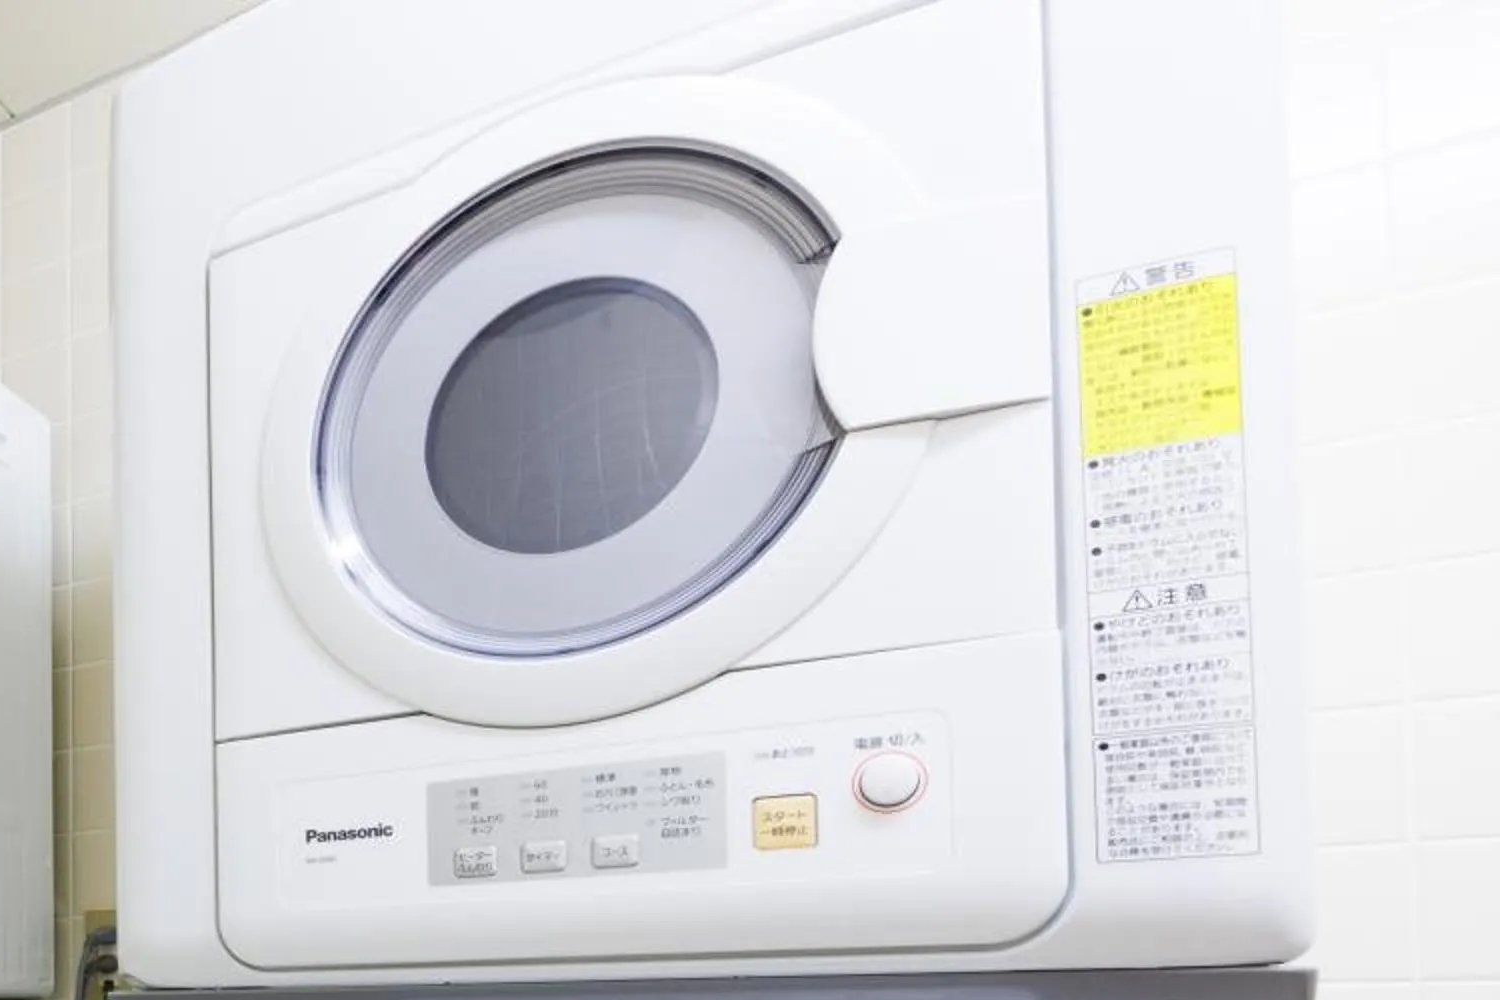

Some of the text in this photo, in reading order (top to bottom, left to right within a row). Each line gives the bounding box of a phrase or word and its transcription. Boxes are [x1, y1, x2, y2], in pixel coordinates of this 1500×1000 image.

[1156, 583, 1207, 606] 注意
[763, 809, 807, 823] スタート
[305, 822, 394, 845] Panasonic
